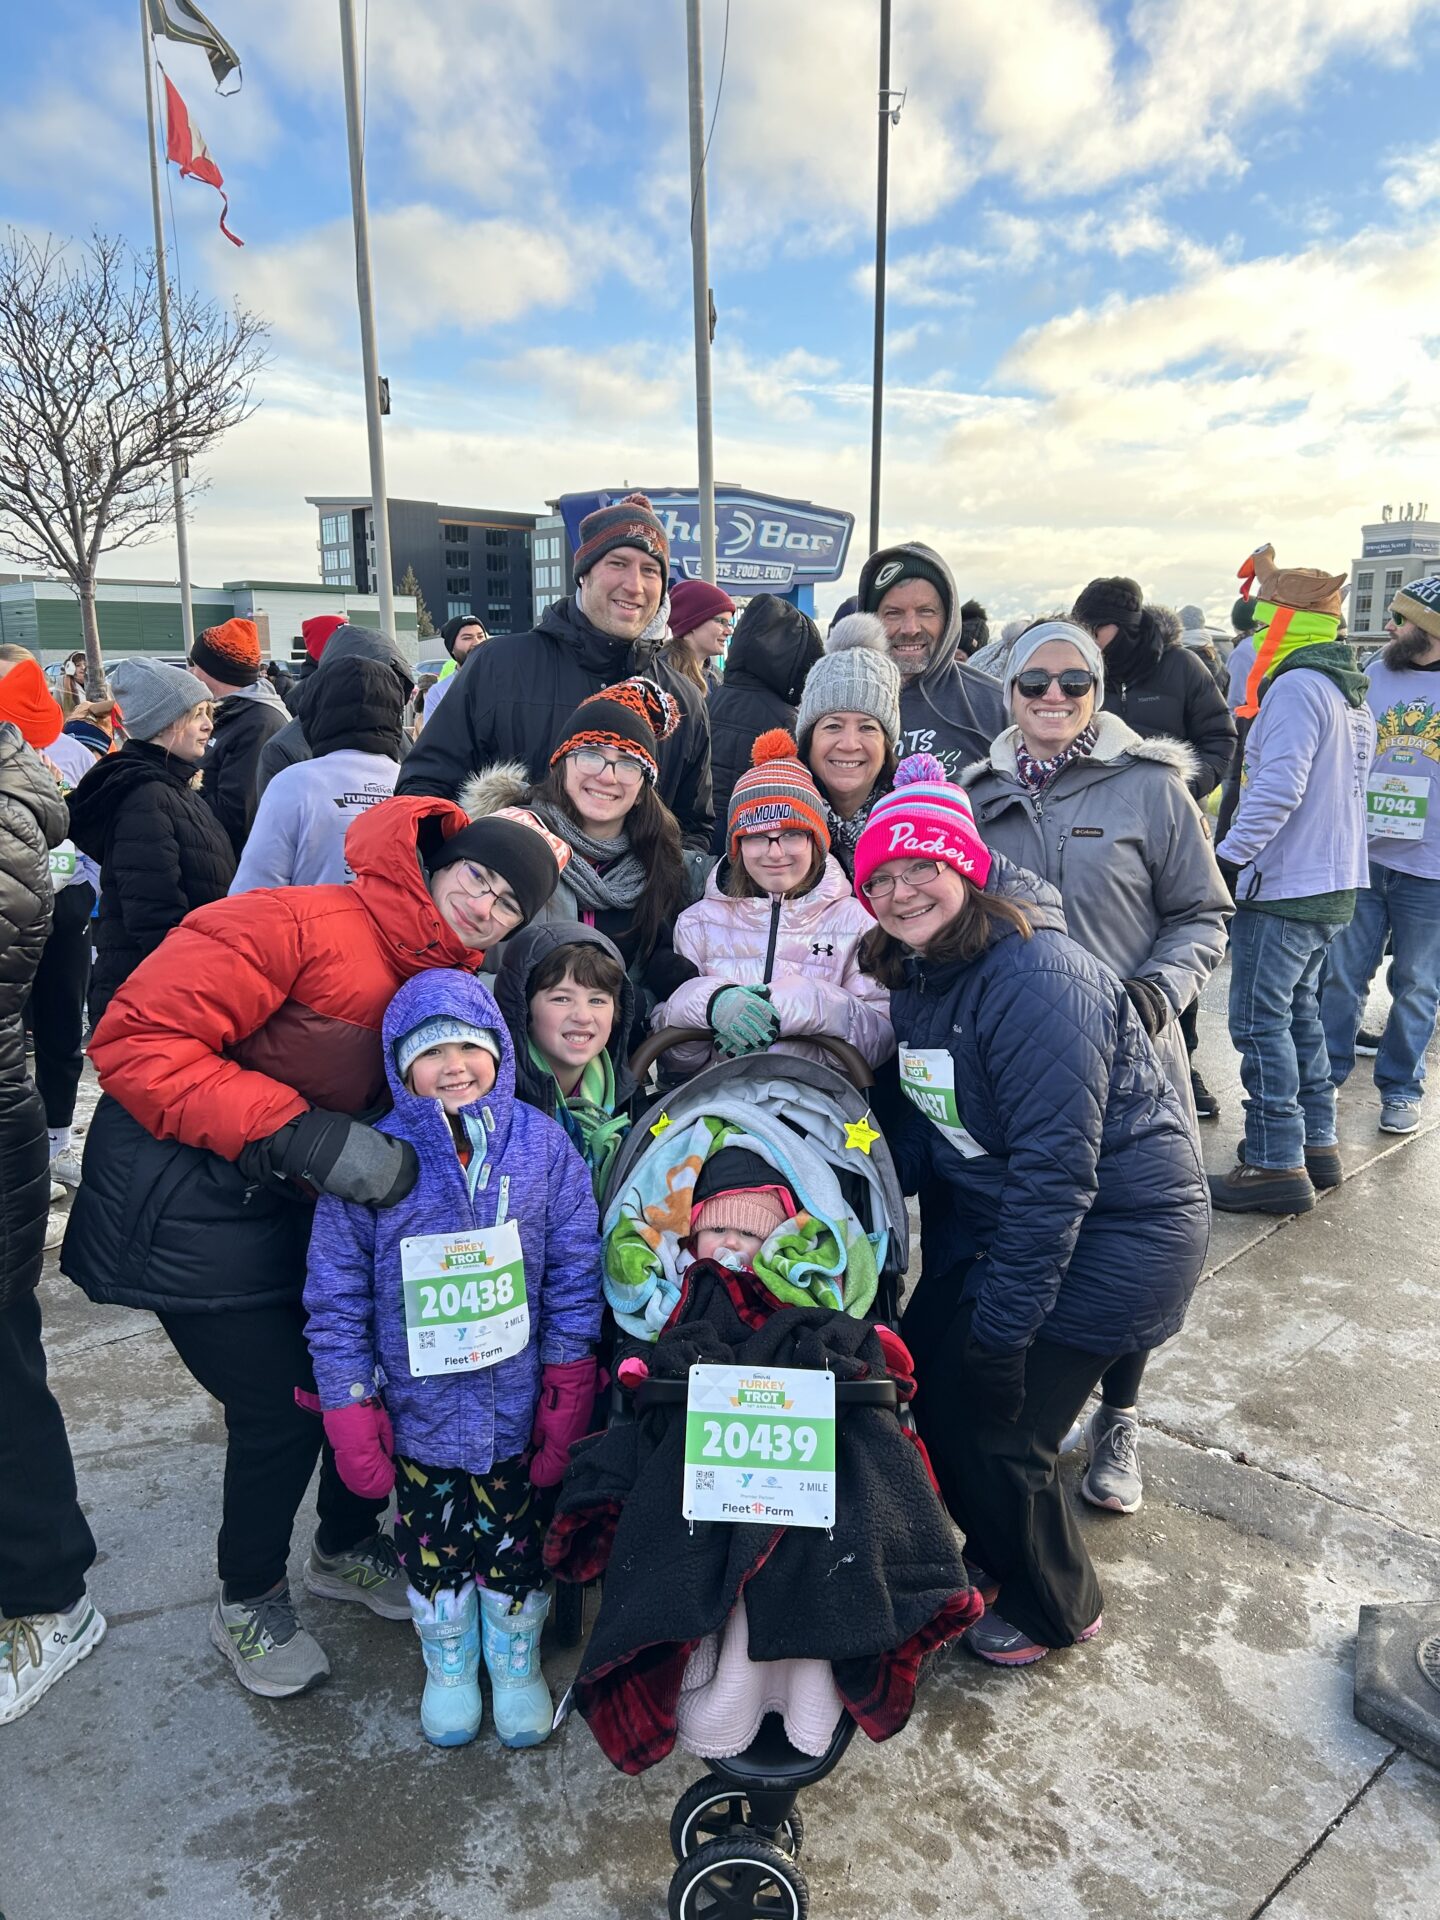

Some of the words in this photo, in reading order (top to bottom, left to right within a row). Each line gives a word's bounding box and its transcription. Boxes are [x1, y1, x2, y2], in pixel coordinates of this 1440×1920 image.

[760, 520, 834, 551] Bar
[735, 564, 760, 578] FOOD
[764, 566, 784, 579] FUN
[1385, 737, 1405, 748] LEG
[1407, 736, 1430, 750] DAY
[1373, 795, 1416, 815] 17944
[753, 803, 792, 823] MOUND
[888, 822, 975, 871] Packers
[406, 1023, 462, 1057] ALASKA
[443, 1241, 484, 1254] TURKEY
[450, 1253, 480, 1265] TROT
[419, 1272, 514, 1319] 20438
[505, 1321, 510, 1329] 2
[510, 1314, 525, 1327] MILE
[444, 1355, 469, 1366] Fleet
[480, 1346, 503, 1360] Farm
[739, 1379, 785, 1390] TURKEY
[744, 1390, 779, 1403] TROT
[702, 1420, 818, 1462] 20439
[799, 1482, 805, 1491] 2
[806, 1483, 828, 1492] MILE
[722, 1503, 751, 1514] Fleet
[765, 1506, 794, 1517] Farm
[436, 1627, 462, 1636] FROZEN
